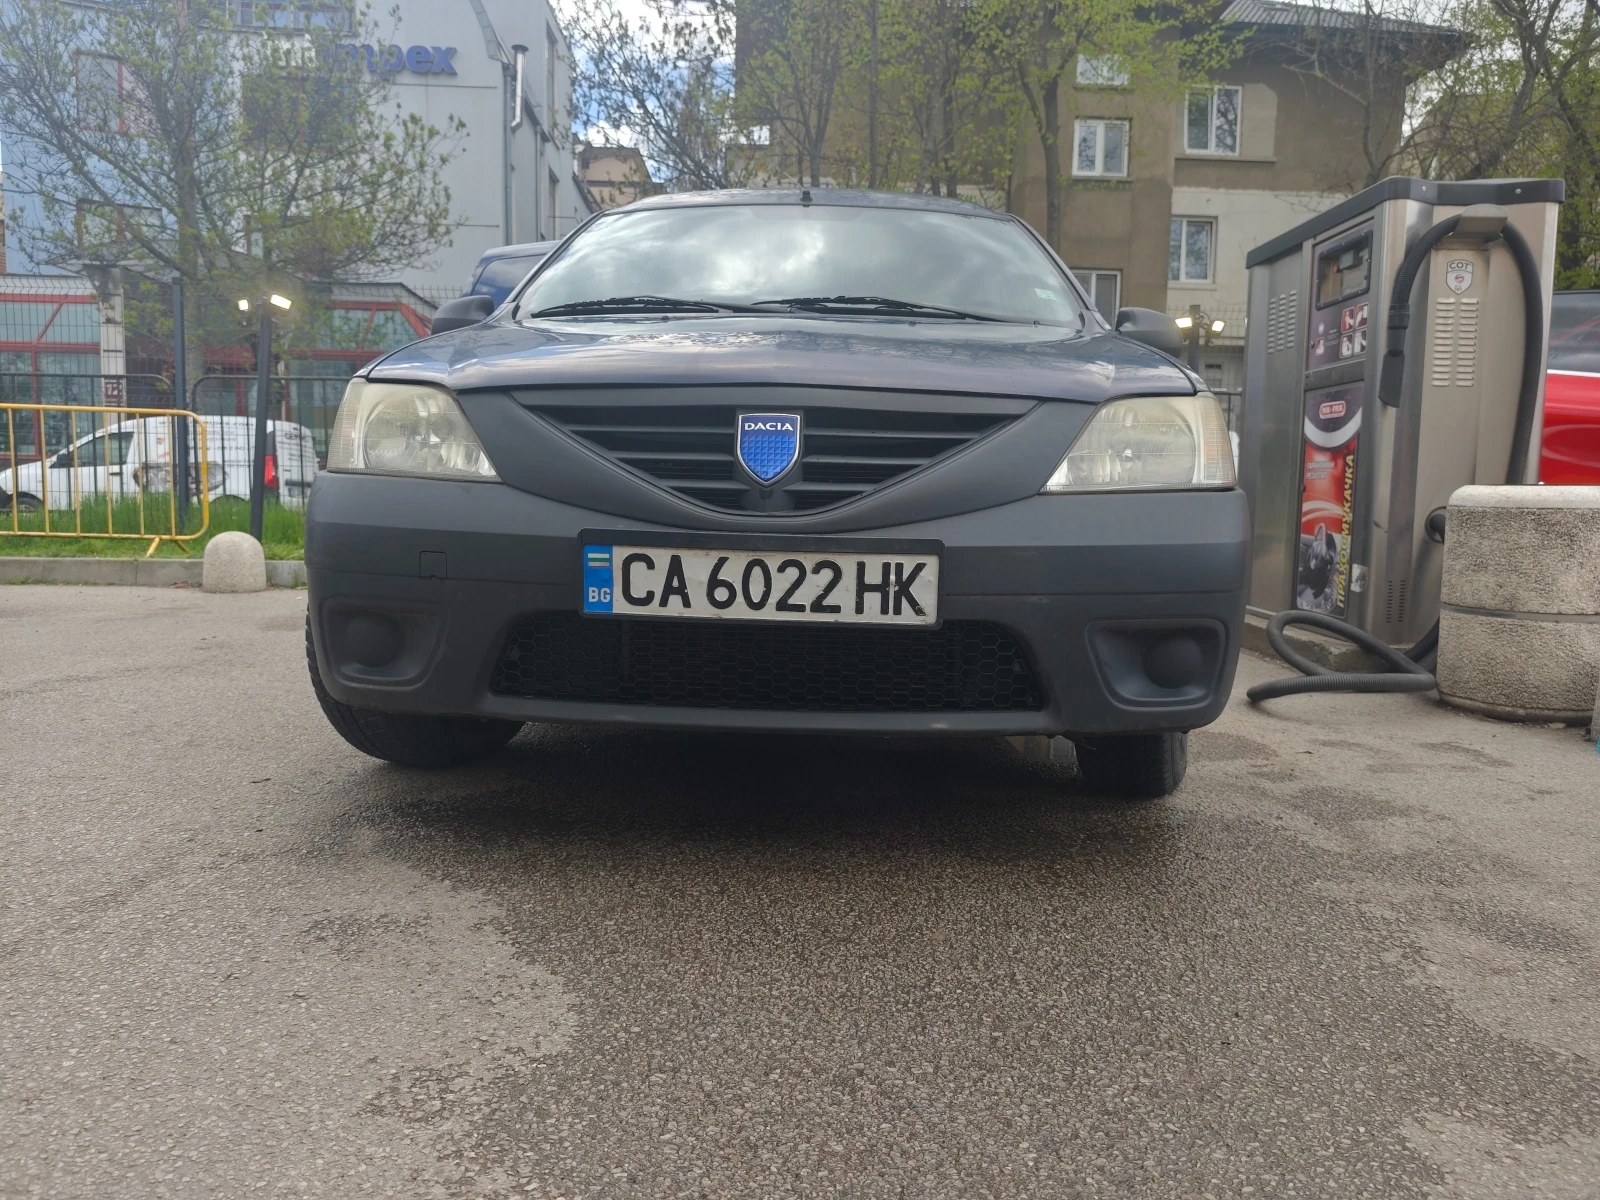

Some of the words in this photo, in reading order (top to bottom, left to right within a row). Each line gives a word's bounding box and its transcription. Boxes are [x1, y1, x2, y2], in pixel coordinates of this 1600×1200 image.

[744, 422, 794, 431] DACIA
[1336, 454, 1355, 608] ПРАХОСМУКАЧКА
[588, 587, 611, 603] BG
[621, 552, 692, 608] CA
[706, 556, 843, 614] 6022
[854, 561, 928, 616] HK
